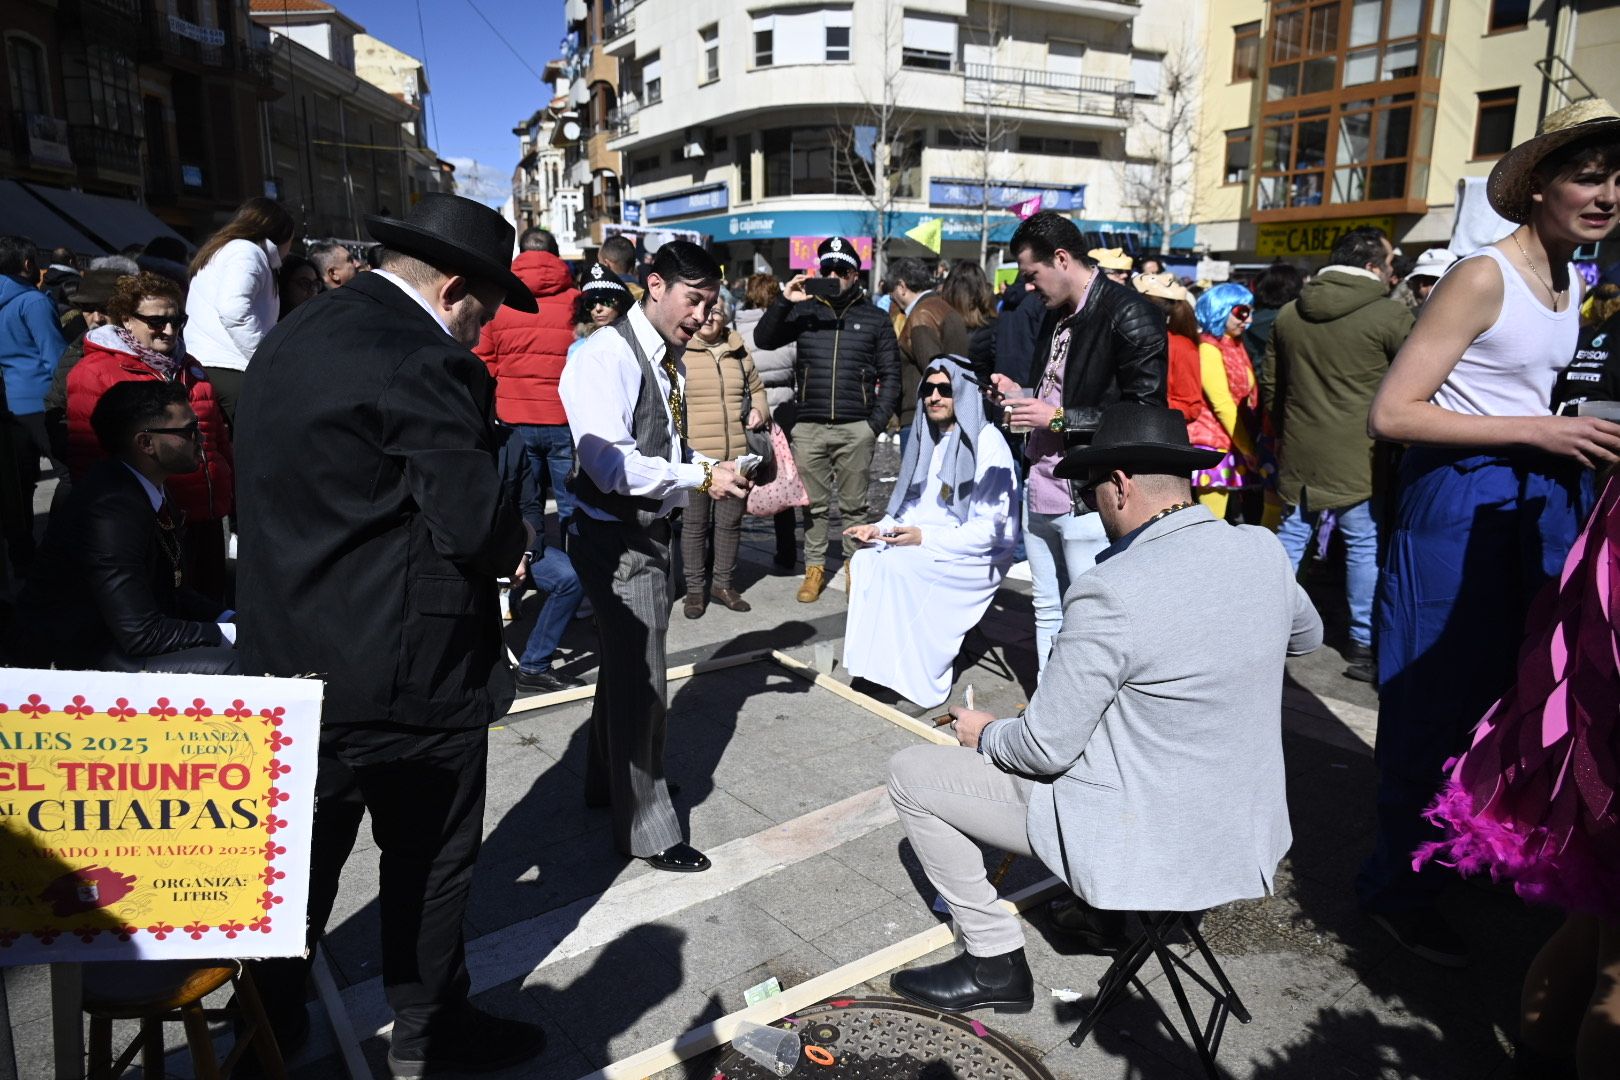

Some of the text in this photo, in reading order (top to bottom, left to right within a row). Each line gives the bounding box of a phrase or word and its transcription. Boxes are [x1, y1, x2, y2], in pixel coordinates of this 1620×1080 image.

[740, 217, 774, 235] cajamar
[1576, 350, 1608, 361] EPSON
[165, 729, 250, 742] LA BAÑEZA
[81, 736, 148, 755] 2025
[57, 762, 251, 791] TRIUNFO
[28, 798, 259, 832] CHAPAS
[116, 845, 141, 857] DE
[146, 844, 213, 857] MARZO
[219, 846, 257, 856] 2025
[153, 877, 247, 889] ORGANIZA:
[173, 890, 228, 902] LITRIS
